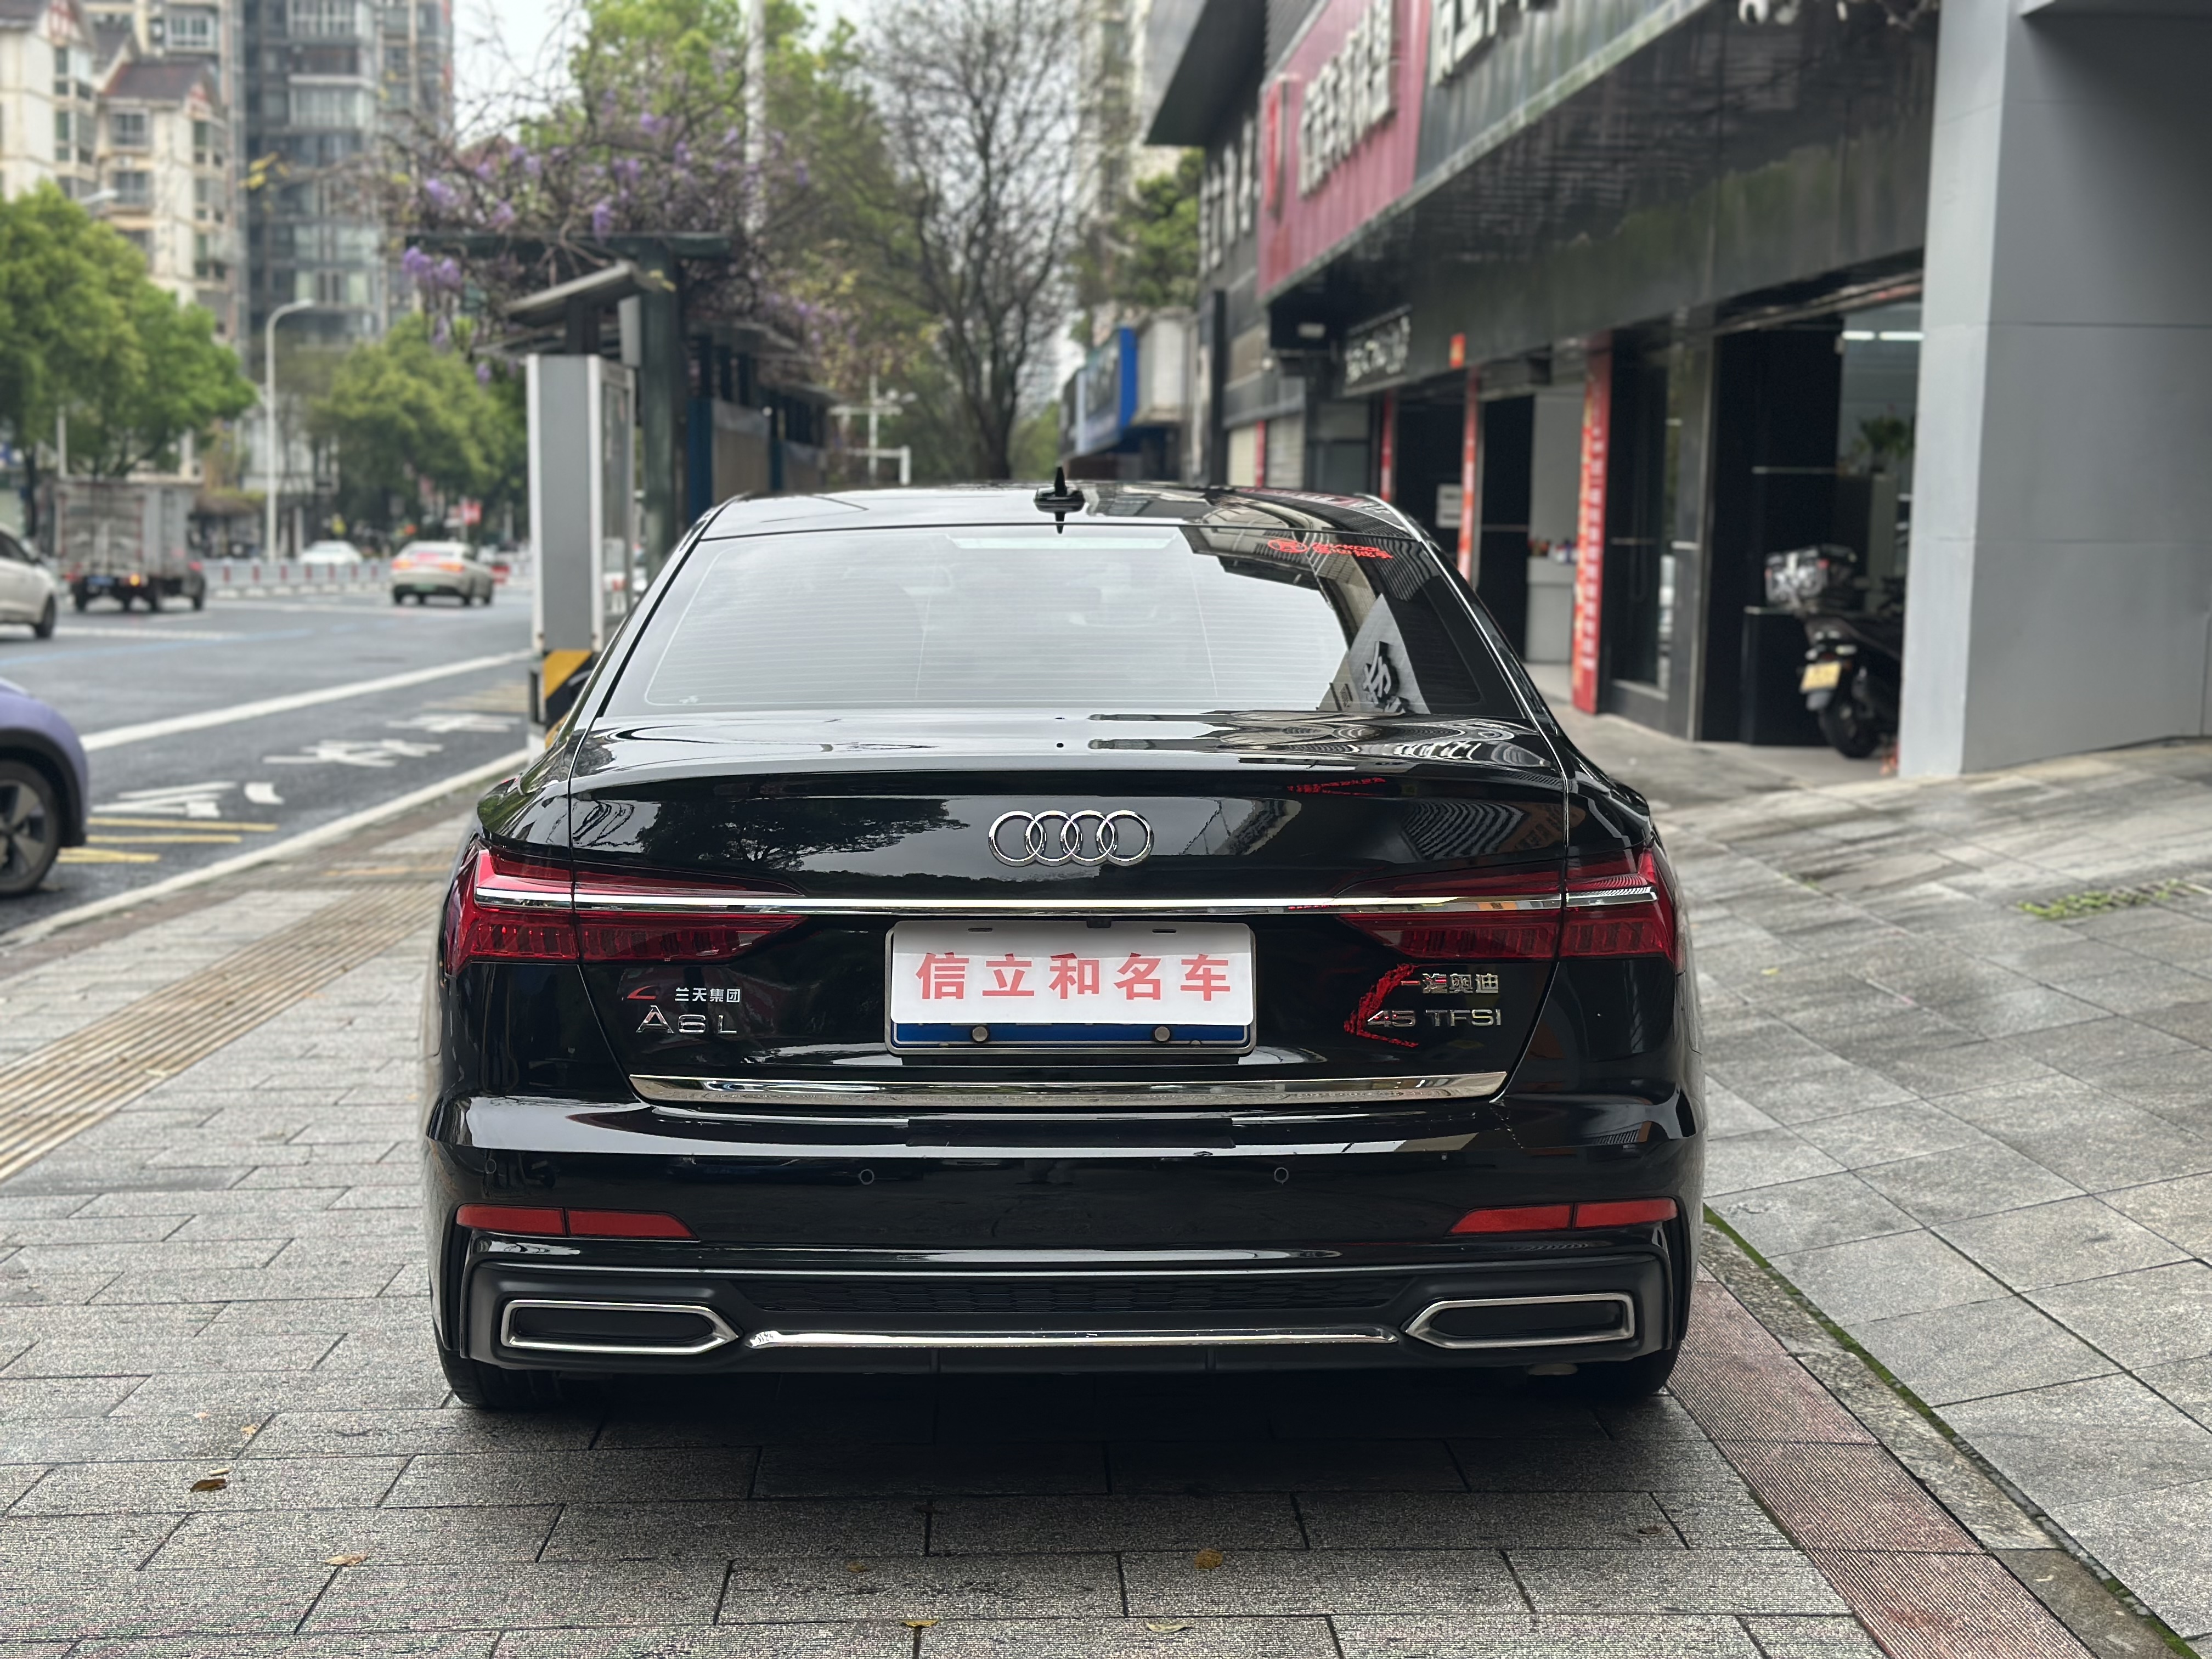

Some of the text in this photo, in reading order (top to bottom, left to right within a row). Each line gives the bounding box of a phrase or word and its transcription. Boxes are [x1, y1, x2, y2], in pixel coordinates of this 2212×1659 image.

[916, 952, 1231, 1001] 信立和名车
[1401, 973, 1499, 994] 一汽奥迪
[675, 987, 741, 1003] 兰天集团
[1367, 1009, 1501, 1027] 45 TFSI
